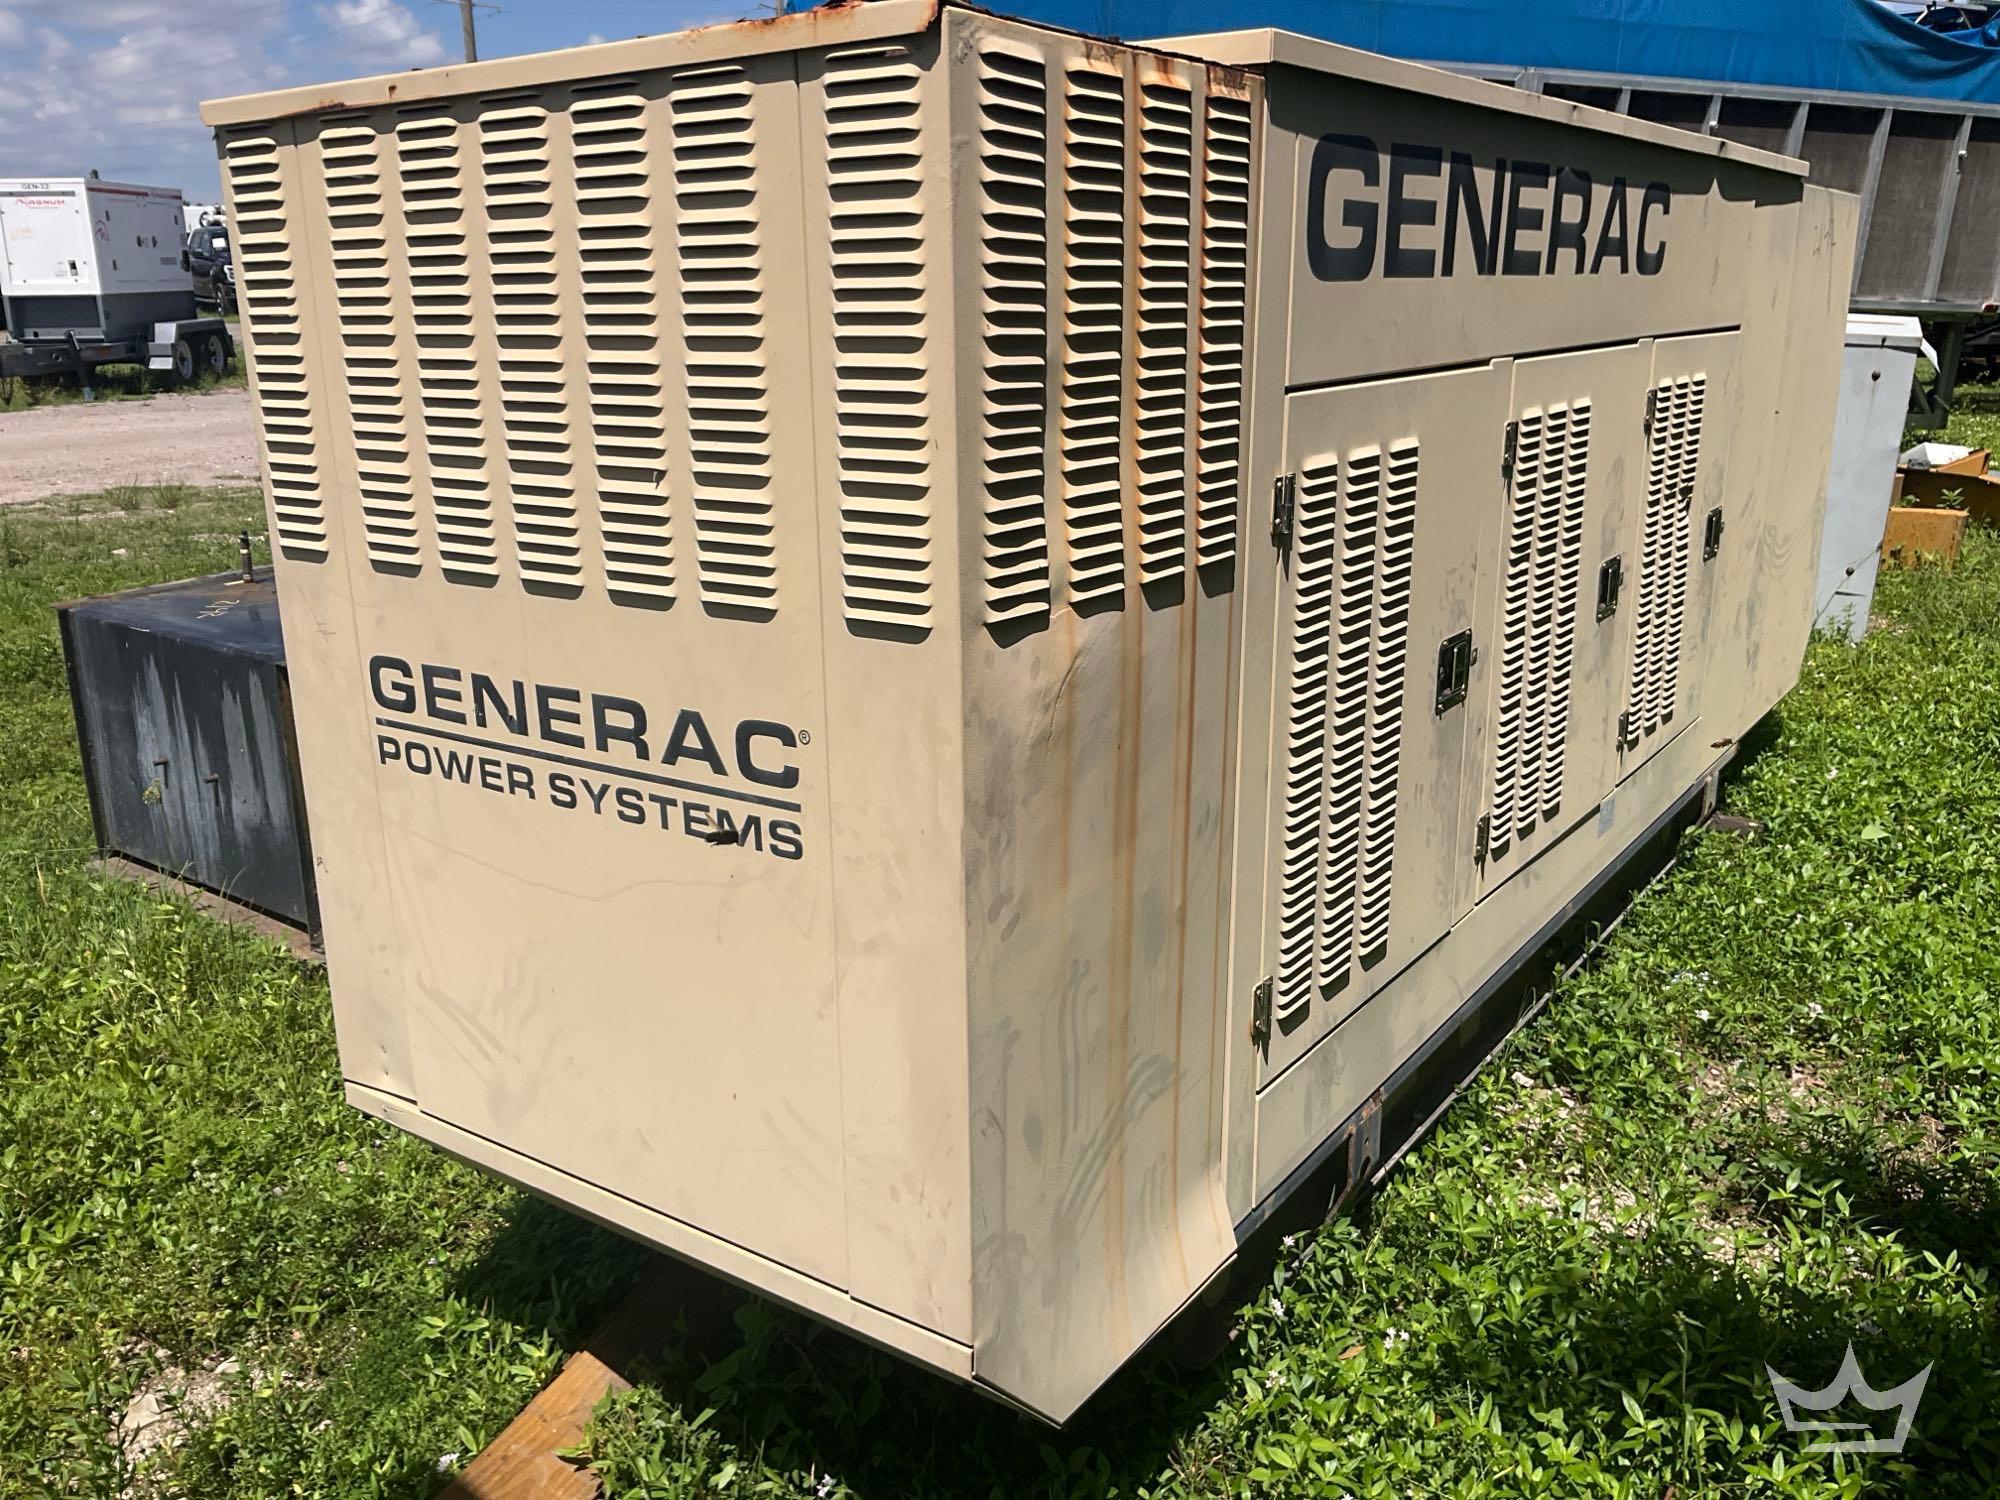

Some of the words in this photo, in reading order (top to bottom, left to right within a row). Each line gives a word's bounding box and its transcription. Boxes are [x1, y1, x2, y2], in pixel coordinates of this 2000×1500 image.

[1306, 133, 1672, 282] GENERAC
[377, 734, 536, 800] POWER
[550, 772, 804, 861] SYSTEMS
